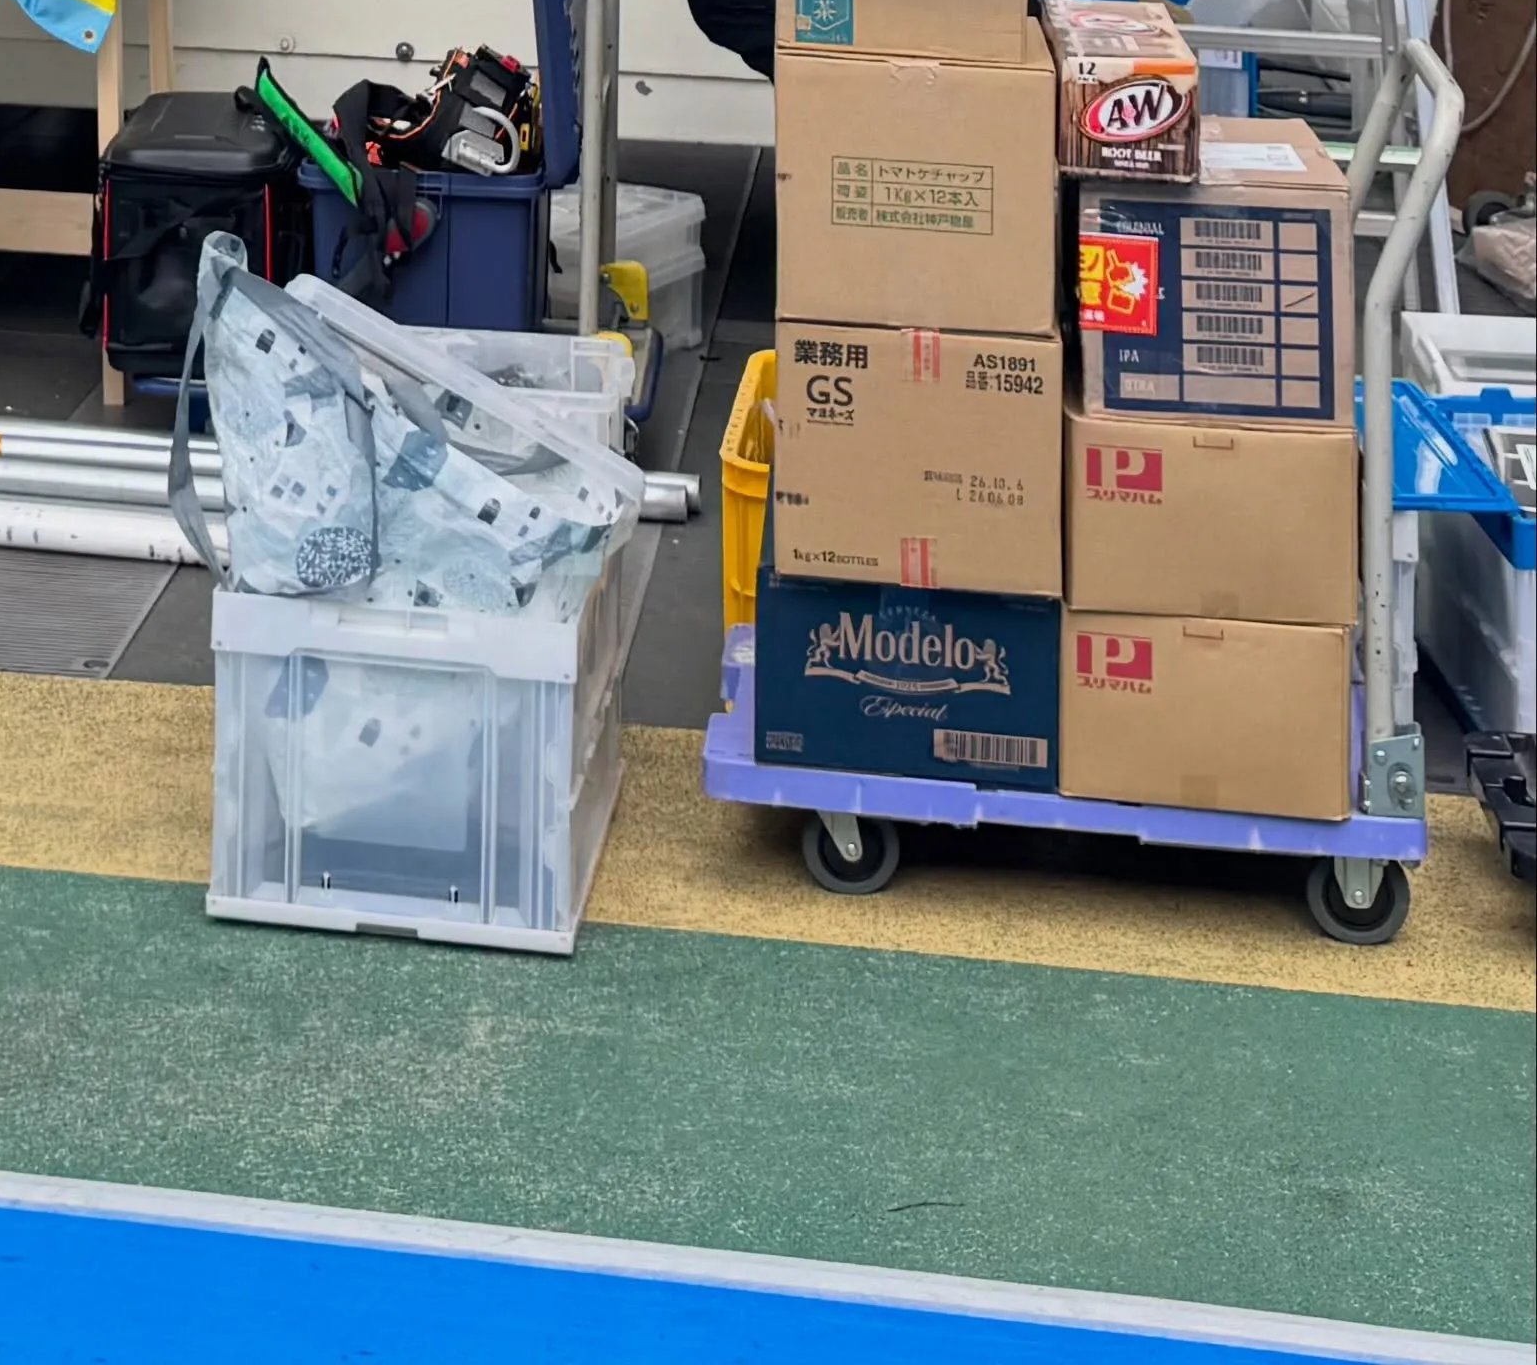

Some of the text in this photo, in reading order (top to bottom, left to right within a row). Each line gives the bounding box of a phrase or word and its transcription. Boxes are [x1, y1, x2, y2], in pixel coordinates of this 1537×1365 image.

[1078, 61, 1096, 75] 12
[1101, 146, 1131, 160] ROOT
[878, 165, 985, 183] トマトケチャップ
[794, 339, 869, 369] 業務用
[973, 354, 1036, 372] AS1891
[1119, 349, 1140, 363] IPA
[806, 374, 854, 406] GS
[839, 612, 975, 670] Modelo
